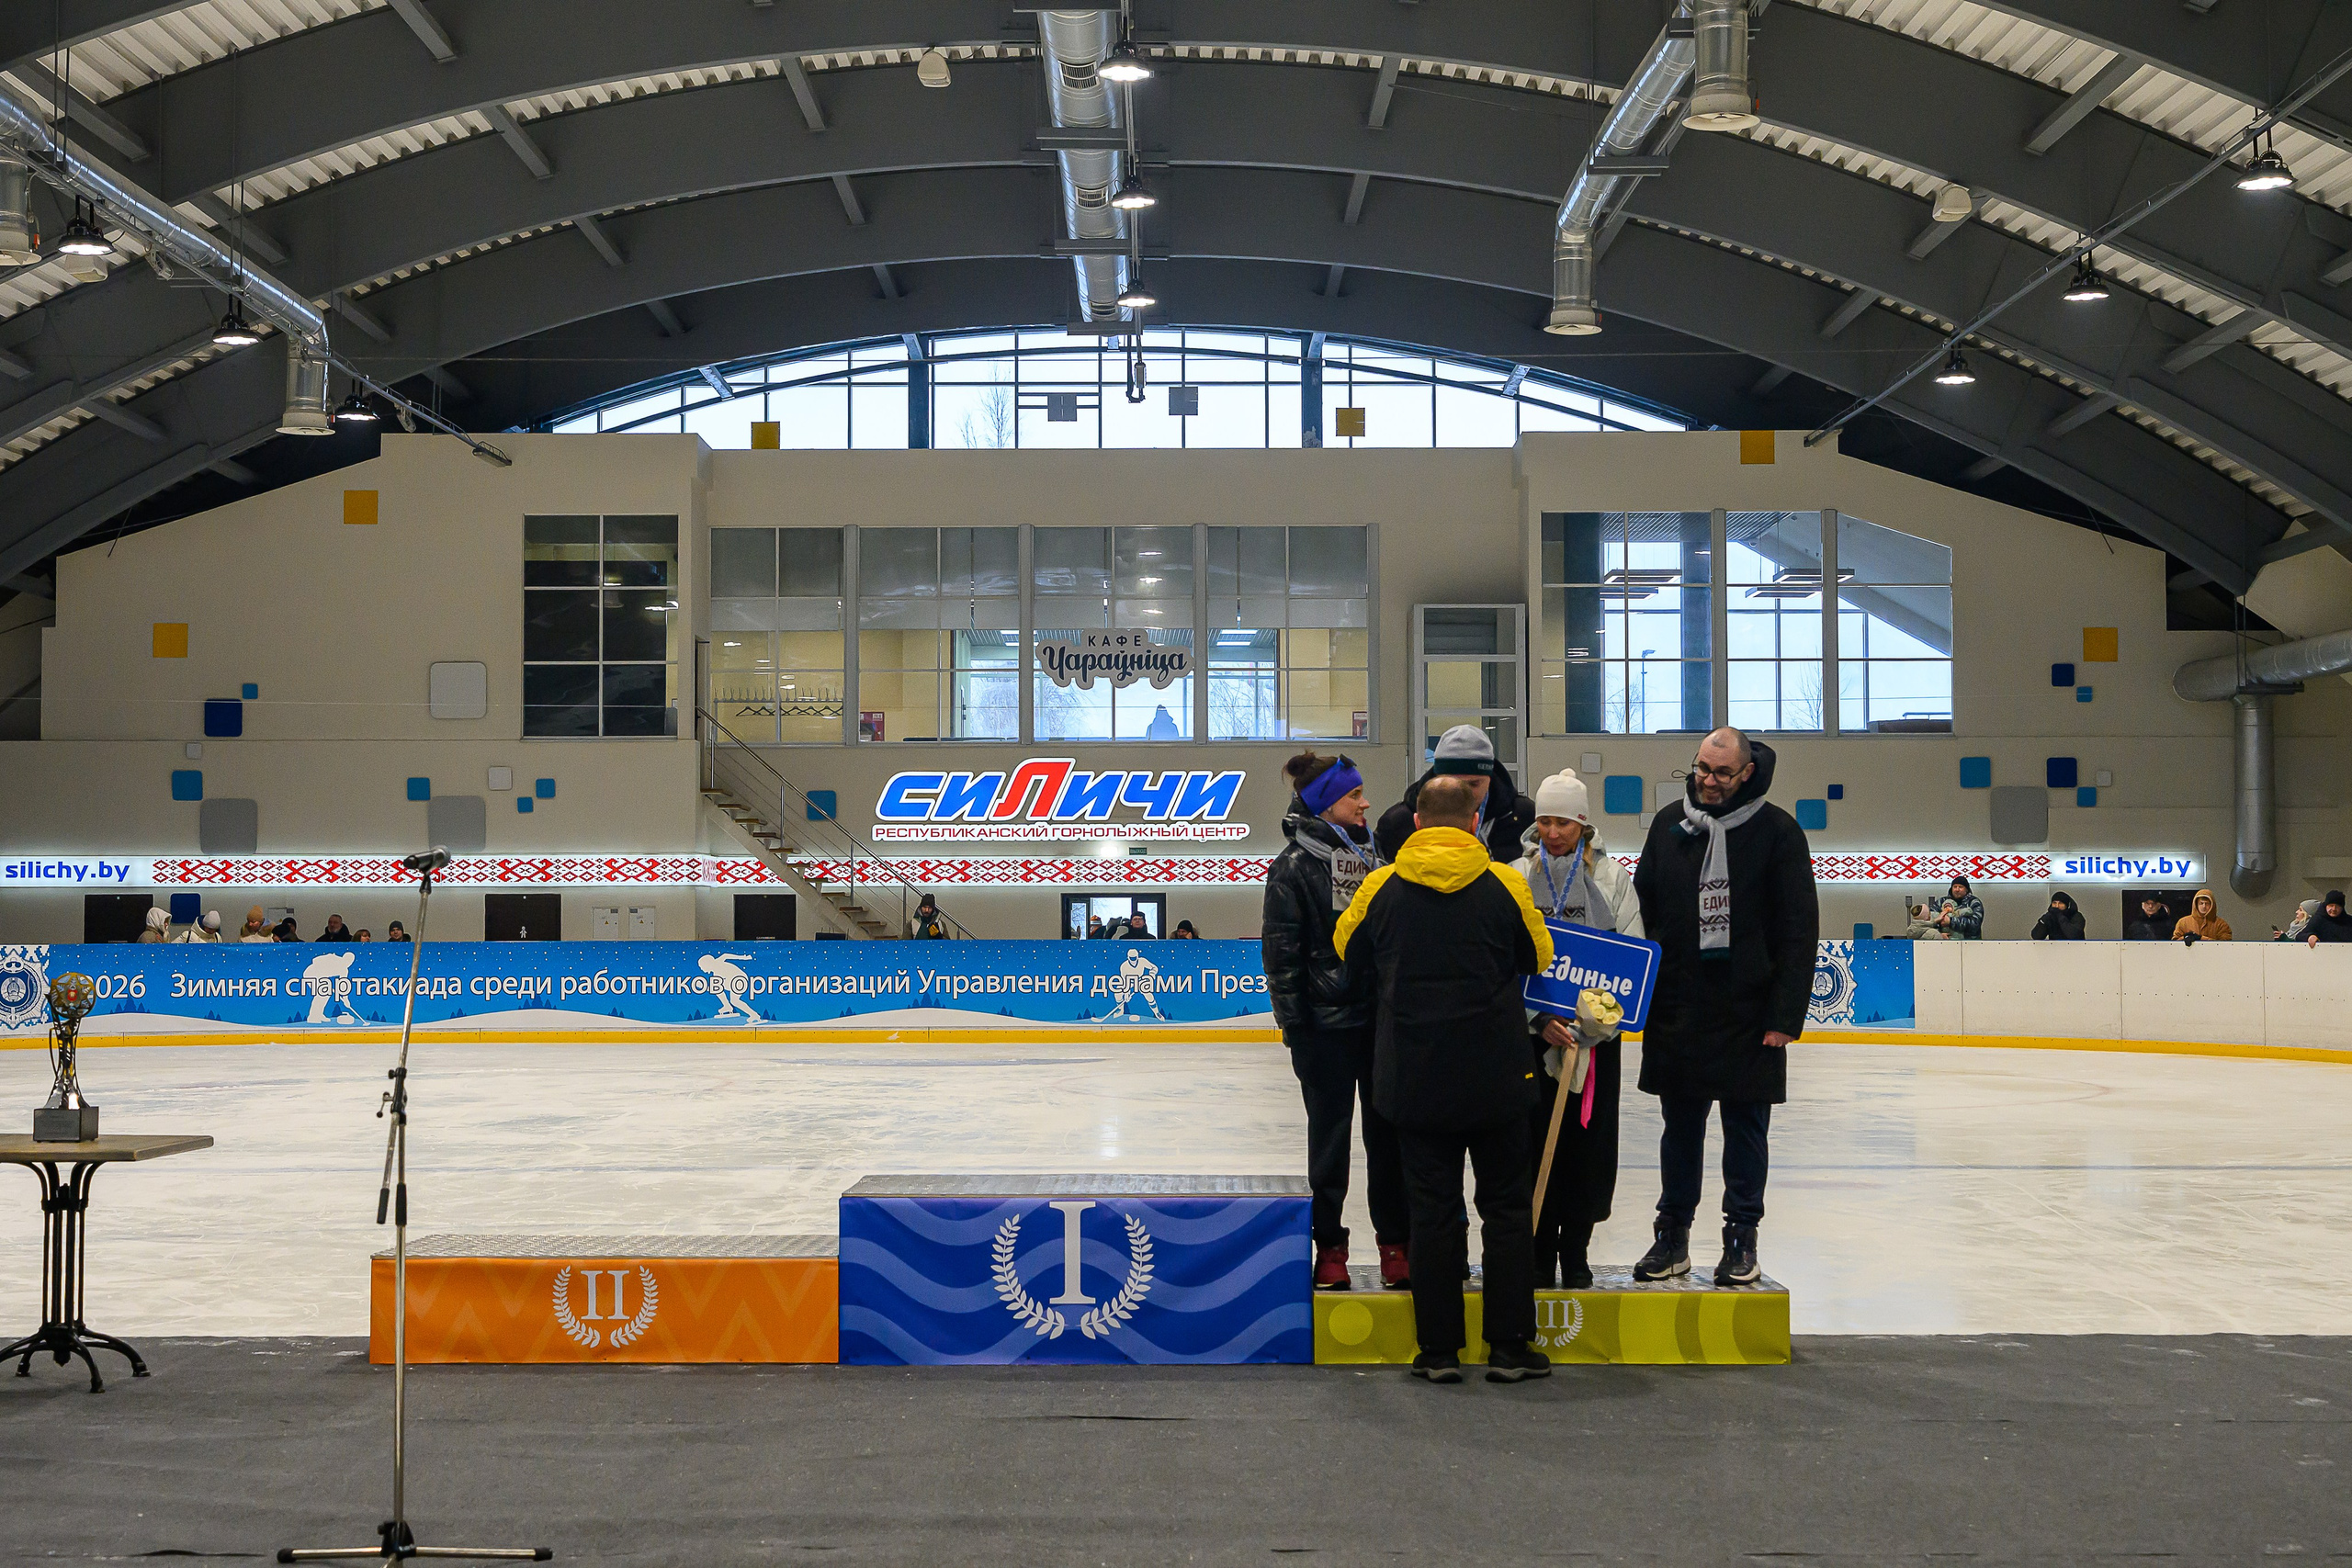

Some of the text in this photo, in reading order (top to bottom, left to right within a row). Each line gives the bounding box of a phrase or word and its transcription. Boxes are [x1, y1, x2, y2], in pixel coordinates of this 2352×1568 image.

[1088, 635, 1142, 647] КАФЕ
[1042, 646, 1188, 683] Чараўніца
[876, 825, 1247, 839] РЕСПУБЛИКАНСКИЙ ГОРНОЛЫЖНЫЙ ЦЕНТР
[5, 861, 130, 883] silichy.by
[2064, 856, 2192, 878] silichy.by
[170, 973, 277, 998] Зимняя
[285, 976, 462, 1002] спартакиада
[469, 976, 552, 1001] среди
[560, 968, 725, 1001] работников
[730, 968, 911, 1000] организаций
[917, 968, 1083, 999] Управления
[1090, 975, 1193, 998] делами
[1541, 953, 1634, 997] Единые
[1048, 1201, 1096, 1304] I
[580, 1269, 630, 1320] II
